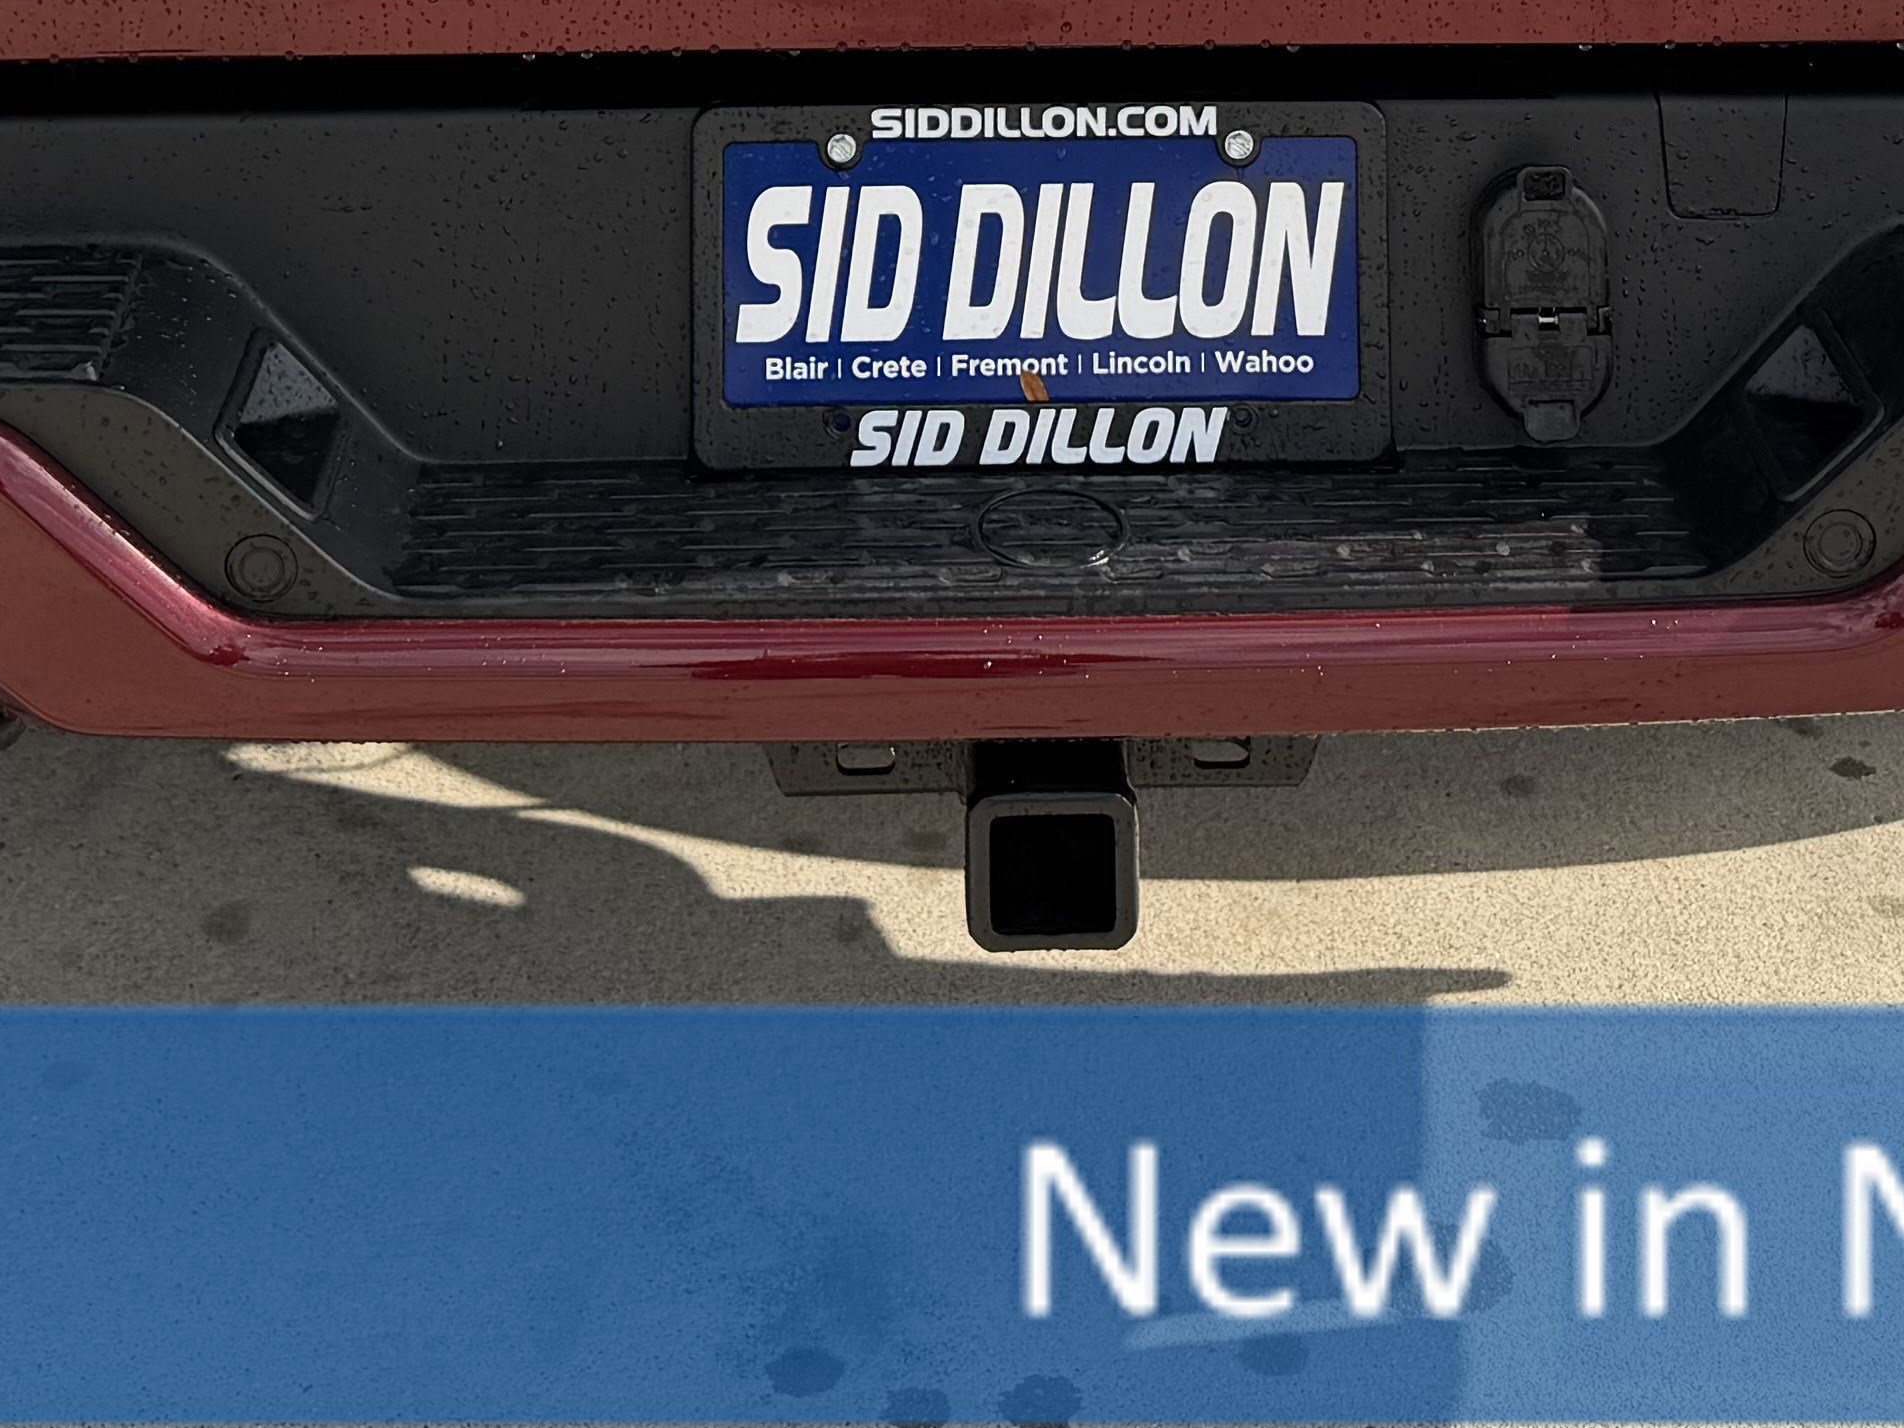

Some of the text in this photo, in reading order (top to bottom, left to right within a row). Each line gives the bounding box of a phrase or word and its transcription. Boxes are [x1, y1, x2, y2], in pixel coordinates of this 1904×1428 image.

[870, 105, 1218, 139] SIDDILLON.COM
[735, 185, 923, 343] SID
[942, 180, 1345, 341] DILLON
[765, 349, 1314, 380] Blair Crete Fremont Lincoln Wahoo
[850, 406, 1228, 467] SID DILLON
